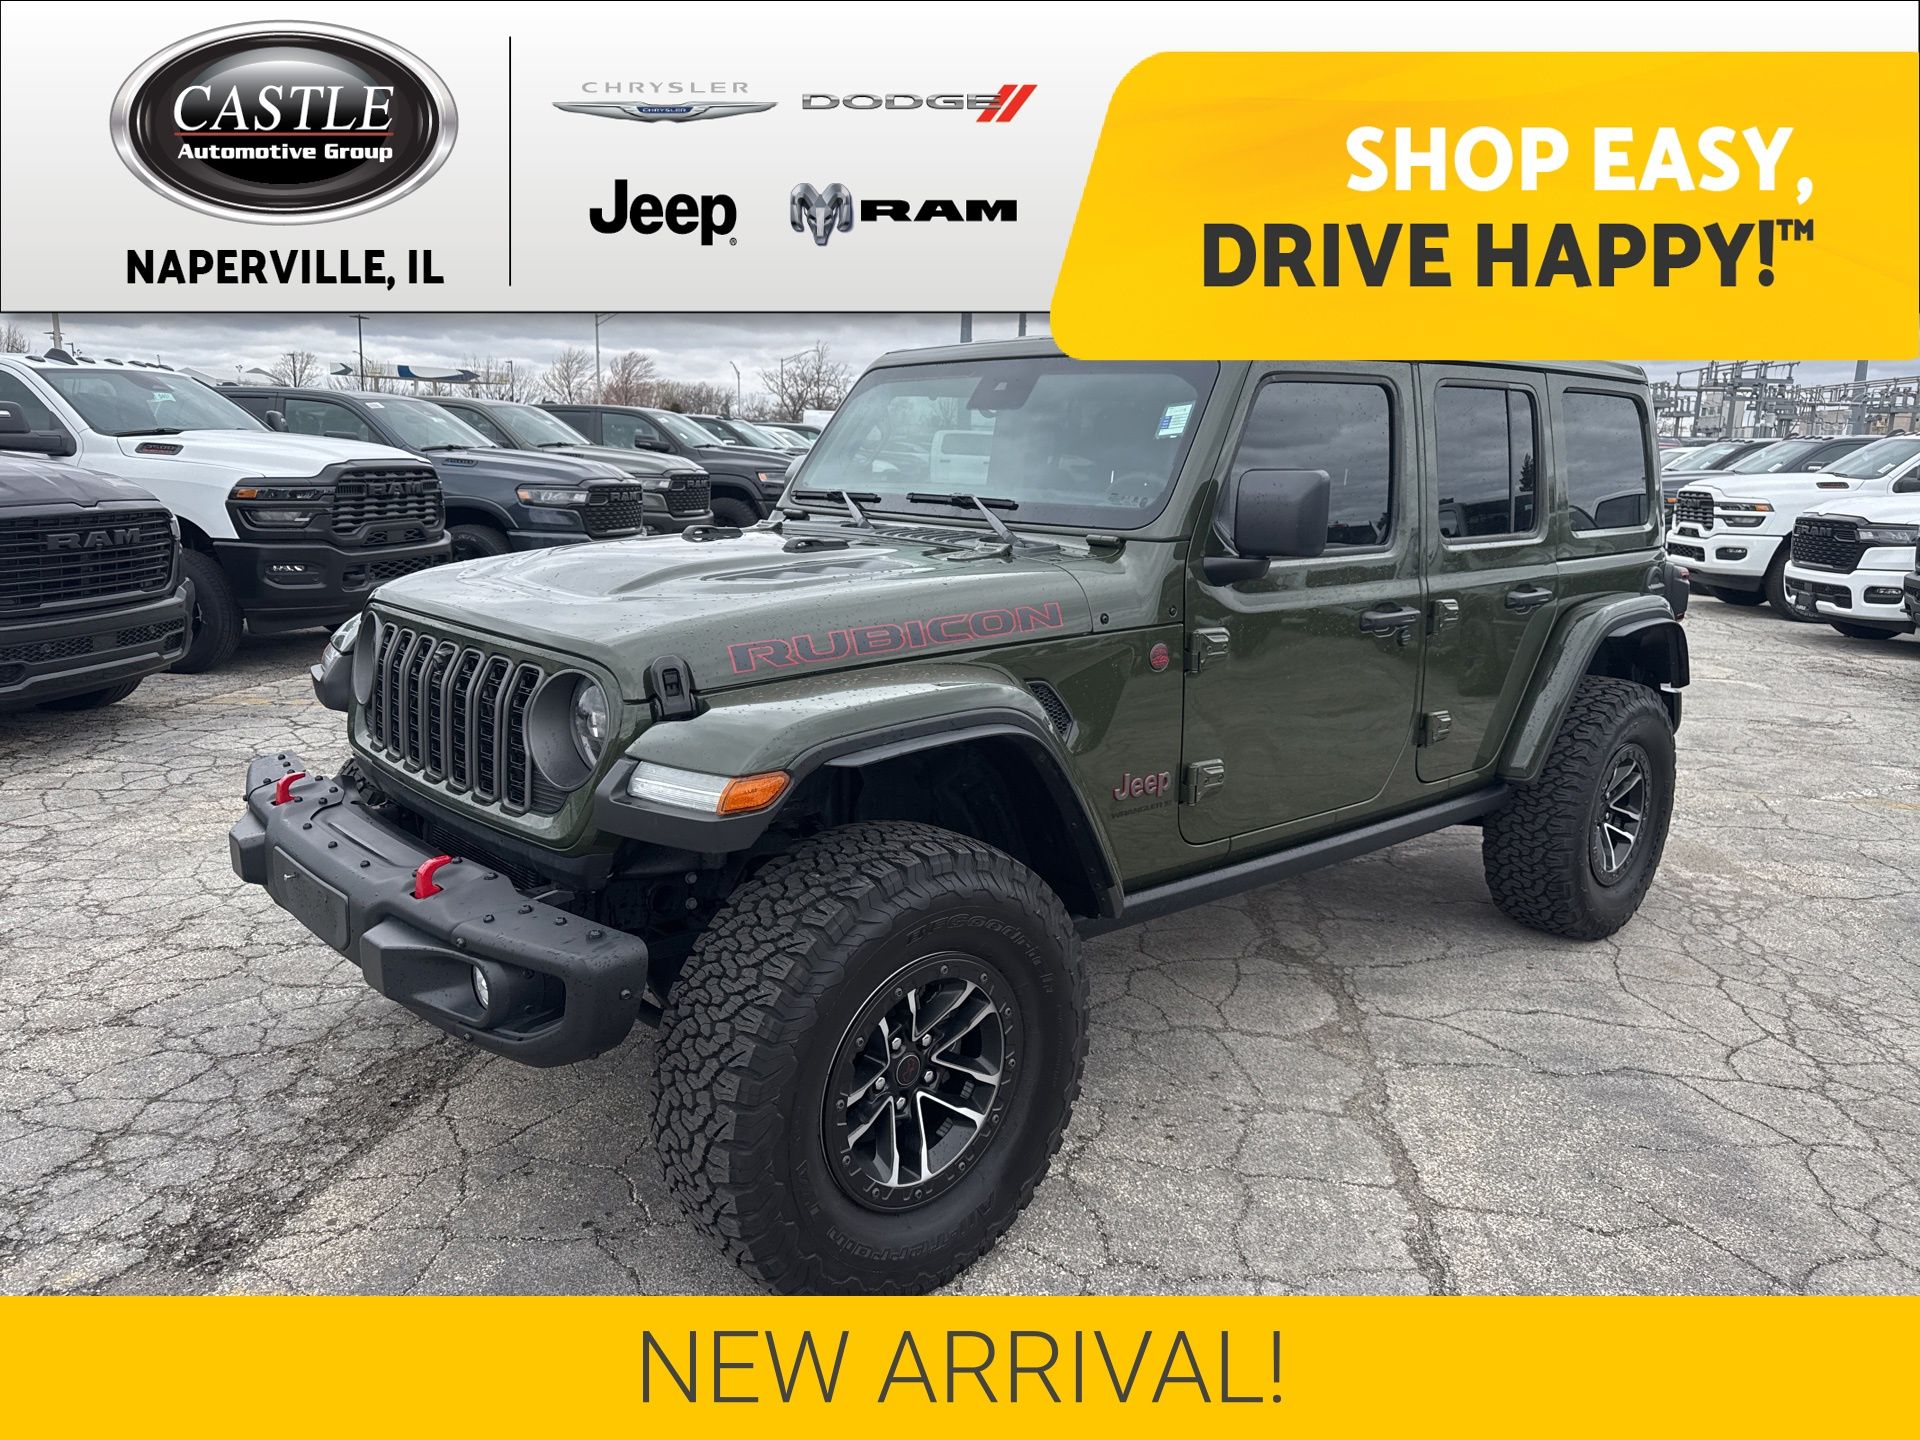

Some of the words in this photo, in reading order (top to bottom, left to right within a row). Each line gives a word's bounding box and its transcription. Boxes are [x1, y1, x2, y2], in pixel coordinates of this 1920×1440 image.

[367, 481, 423, 496] RAM
[610, 491, 641, 501] RAM
[46, 528, 141, 551] RAM
[1801, 525, 1832, 537] RAM
[727, 602, 1064, 675] RUBICON
[1112, 771, 1172, 801] Jeep
